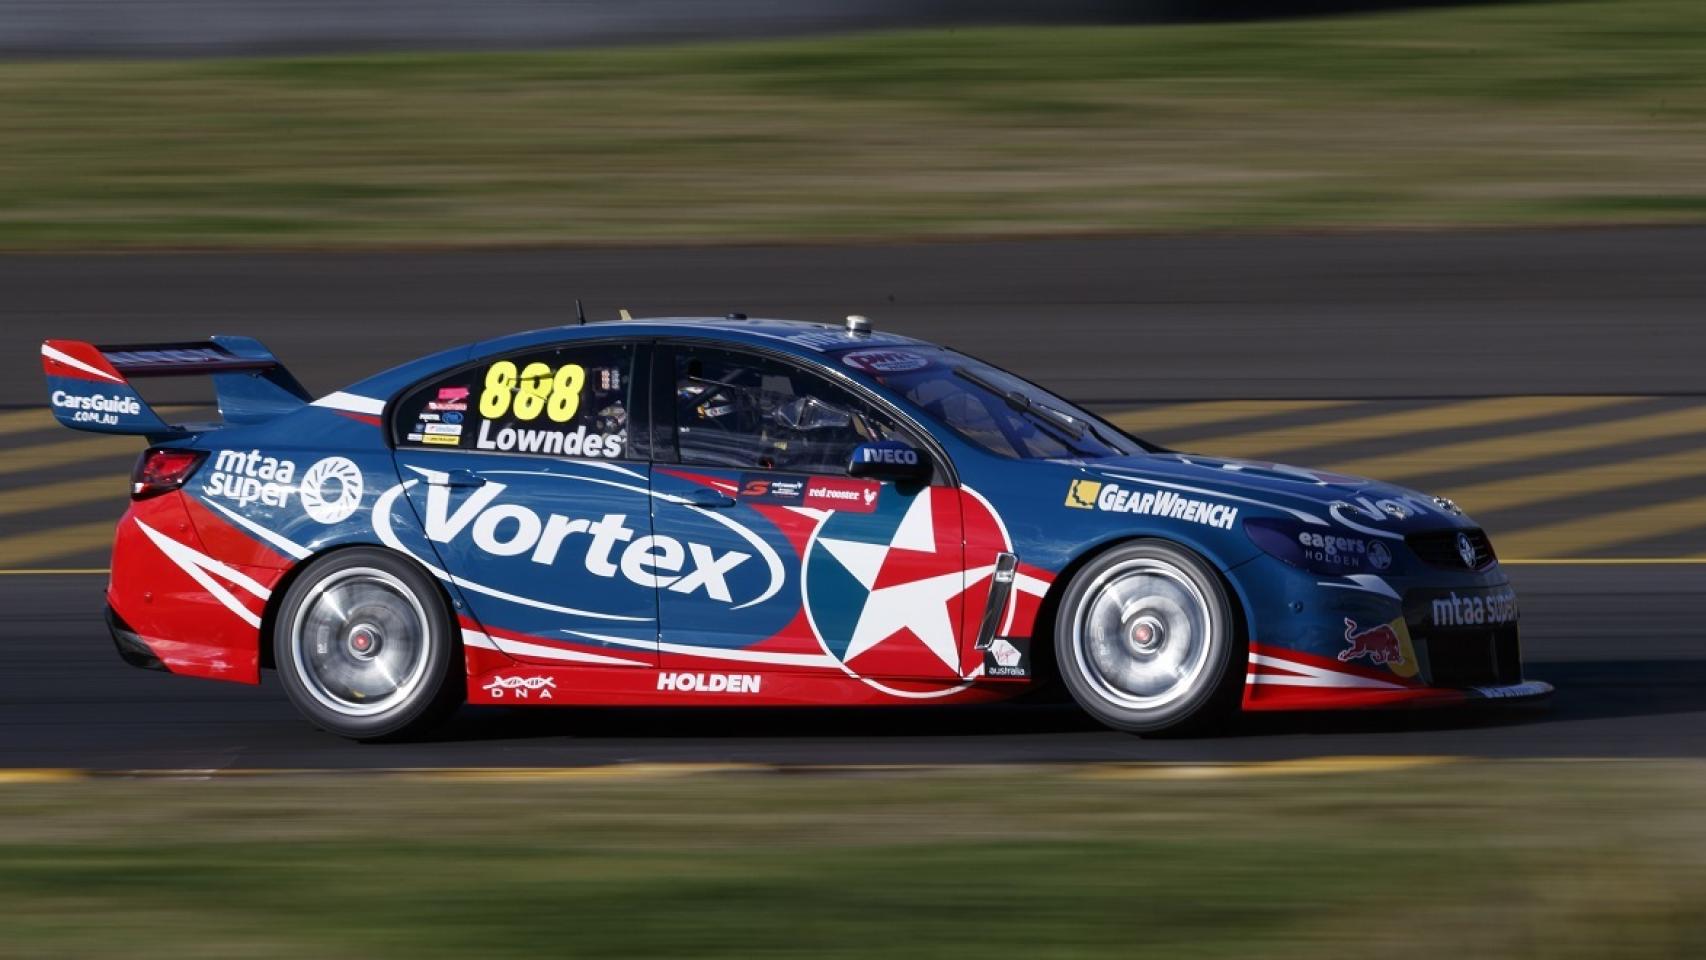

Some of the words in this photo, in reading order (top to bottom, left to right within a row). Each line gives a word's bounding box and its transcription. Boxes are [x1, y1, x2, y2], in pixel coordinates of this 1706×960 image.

[52, 391, 141, 416] CarsGuide
[479, 360, 586, 422] 888
[476, 419, 622, 458] Lowndes
[214, 449, 296, 484] mtaa
[863, 447, 918, 466] IVECO
[207, 470, 293, 508] super
[808, 487, 827, 497] red
[827, 489, 860, 501] rooster
[405, 461, 751, 604] Vortex
[1298, 531, 1366, 557] eagers
[1304, 550, 1360, 568] HOLDEN
[1432, 591, 1485, 627] mtaa
[656, 672, 762, 693] HOLDEN
[988, 666, 1025, 676] australia
[491, 688, 553, 699] DNA
